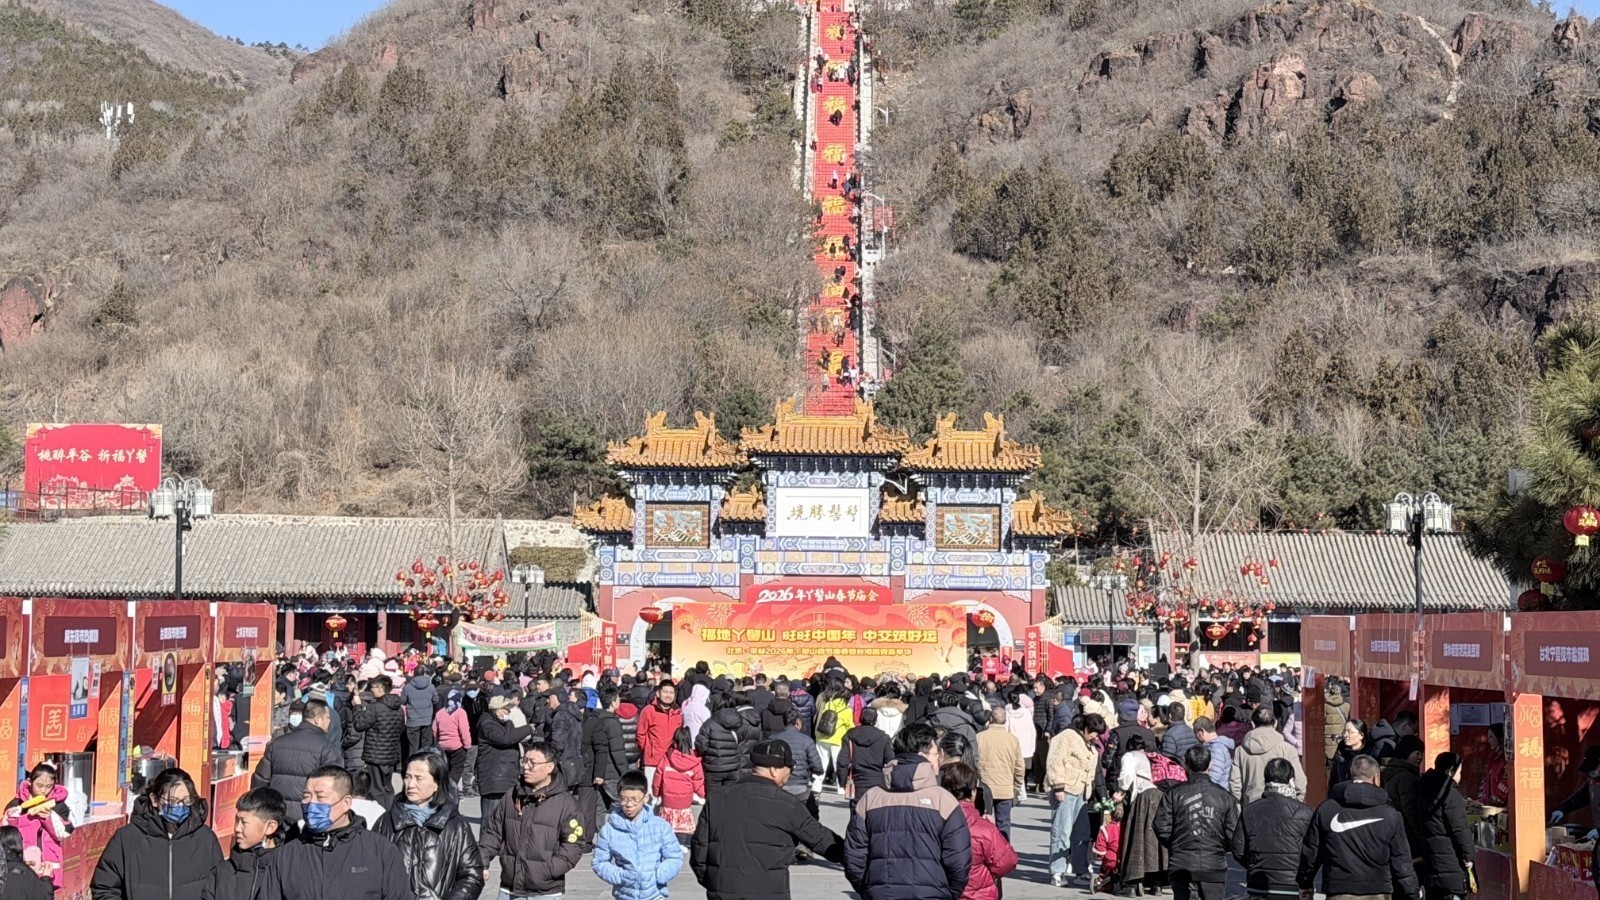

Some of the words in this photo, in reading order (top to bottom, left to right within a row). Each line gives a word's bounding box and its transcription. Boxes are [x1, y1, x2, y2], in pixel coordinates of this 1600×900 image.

[823, 143, 846, 164] 福
[823, 195, 846, 215] 福
[756, 586, 880, 604] 2026年丫髻山春节庙会
[701, 628, 776, 643] 福地丫髻山
[862, 628, 939, 643] 中交筑好运
